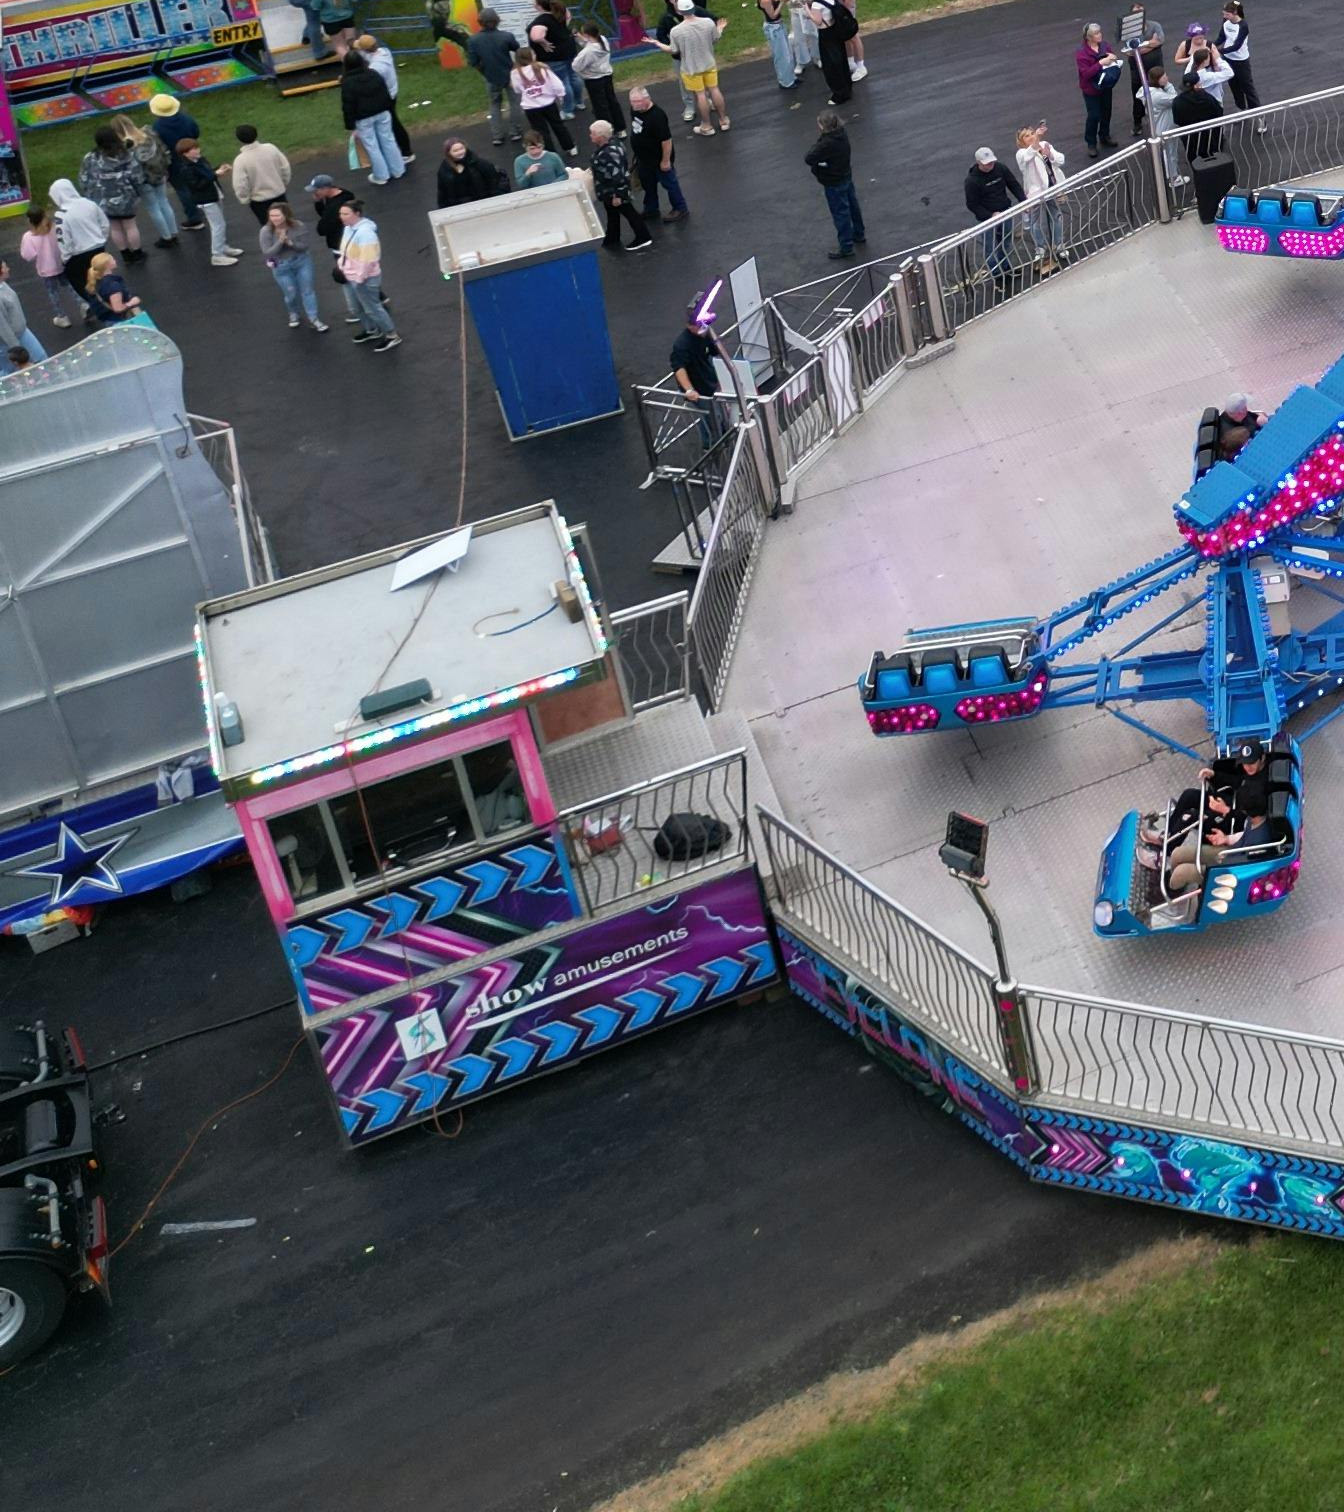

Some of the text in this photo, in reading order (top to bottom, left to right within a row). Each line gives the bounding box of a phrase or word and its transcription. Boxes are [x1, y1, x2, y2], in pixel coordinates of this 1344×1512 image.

[213, 22, 260, 45] ENTRY
[465, 926, 690, 1019] show amusements
